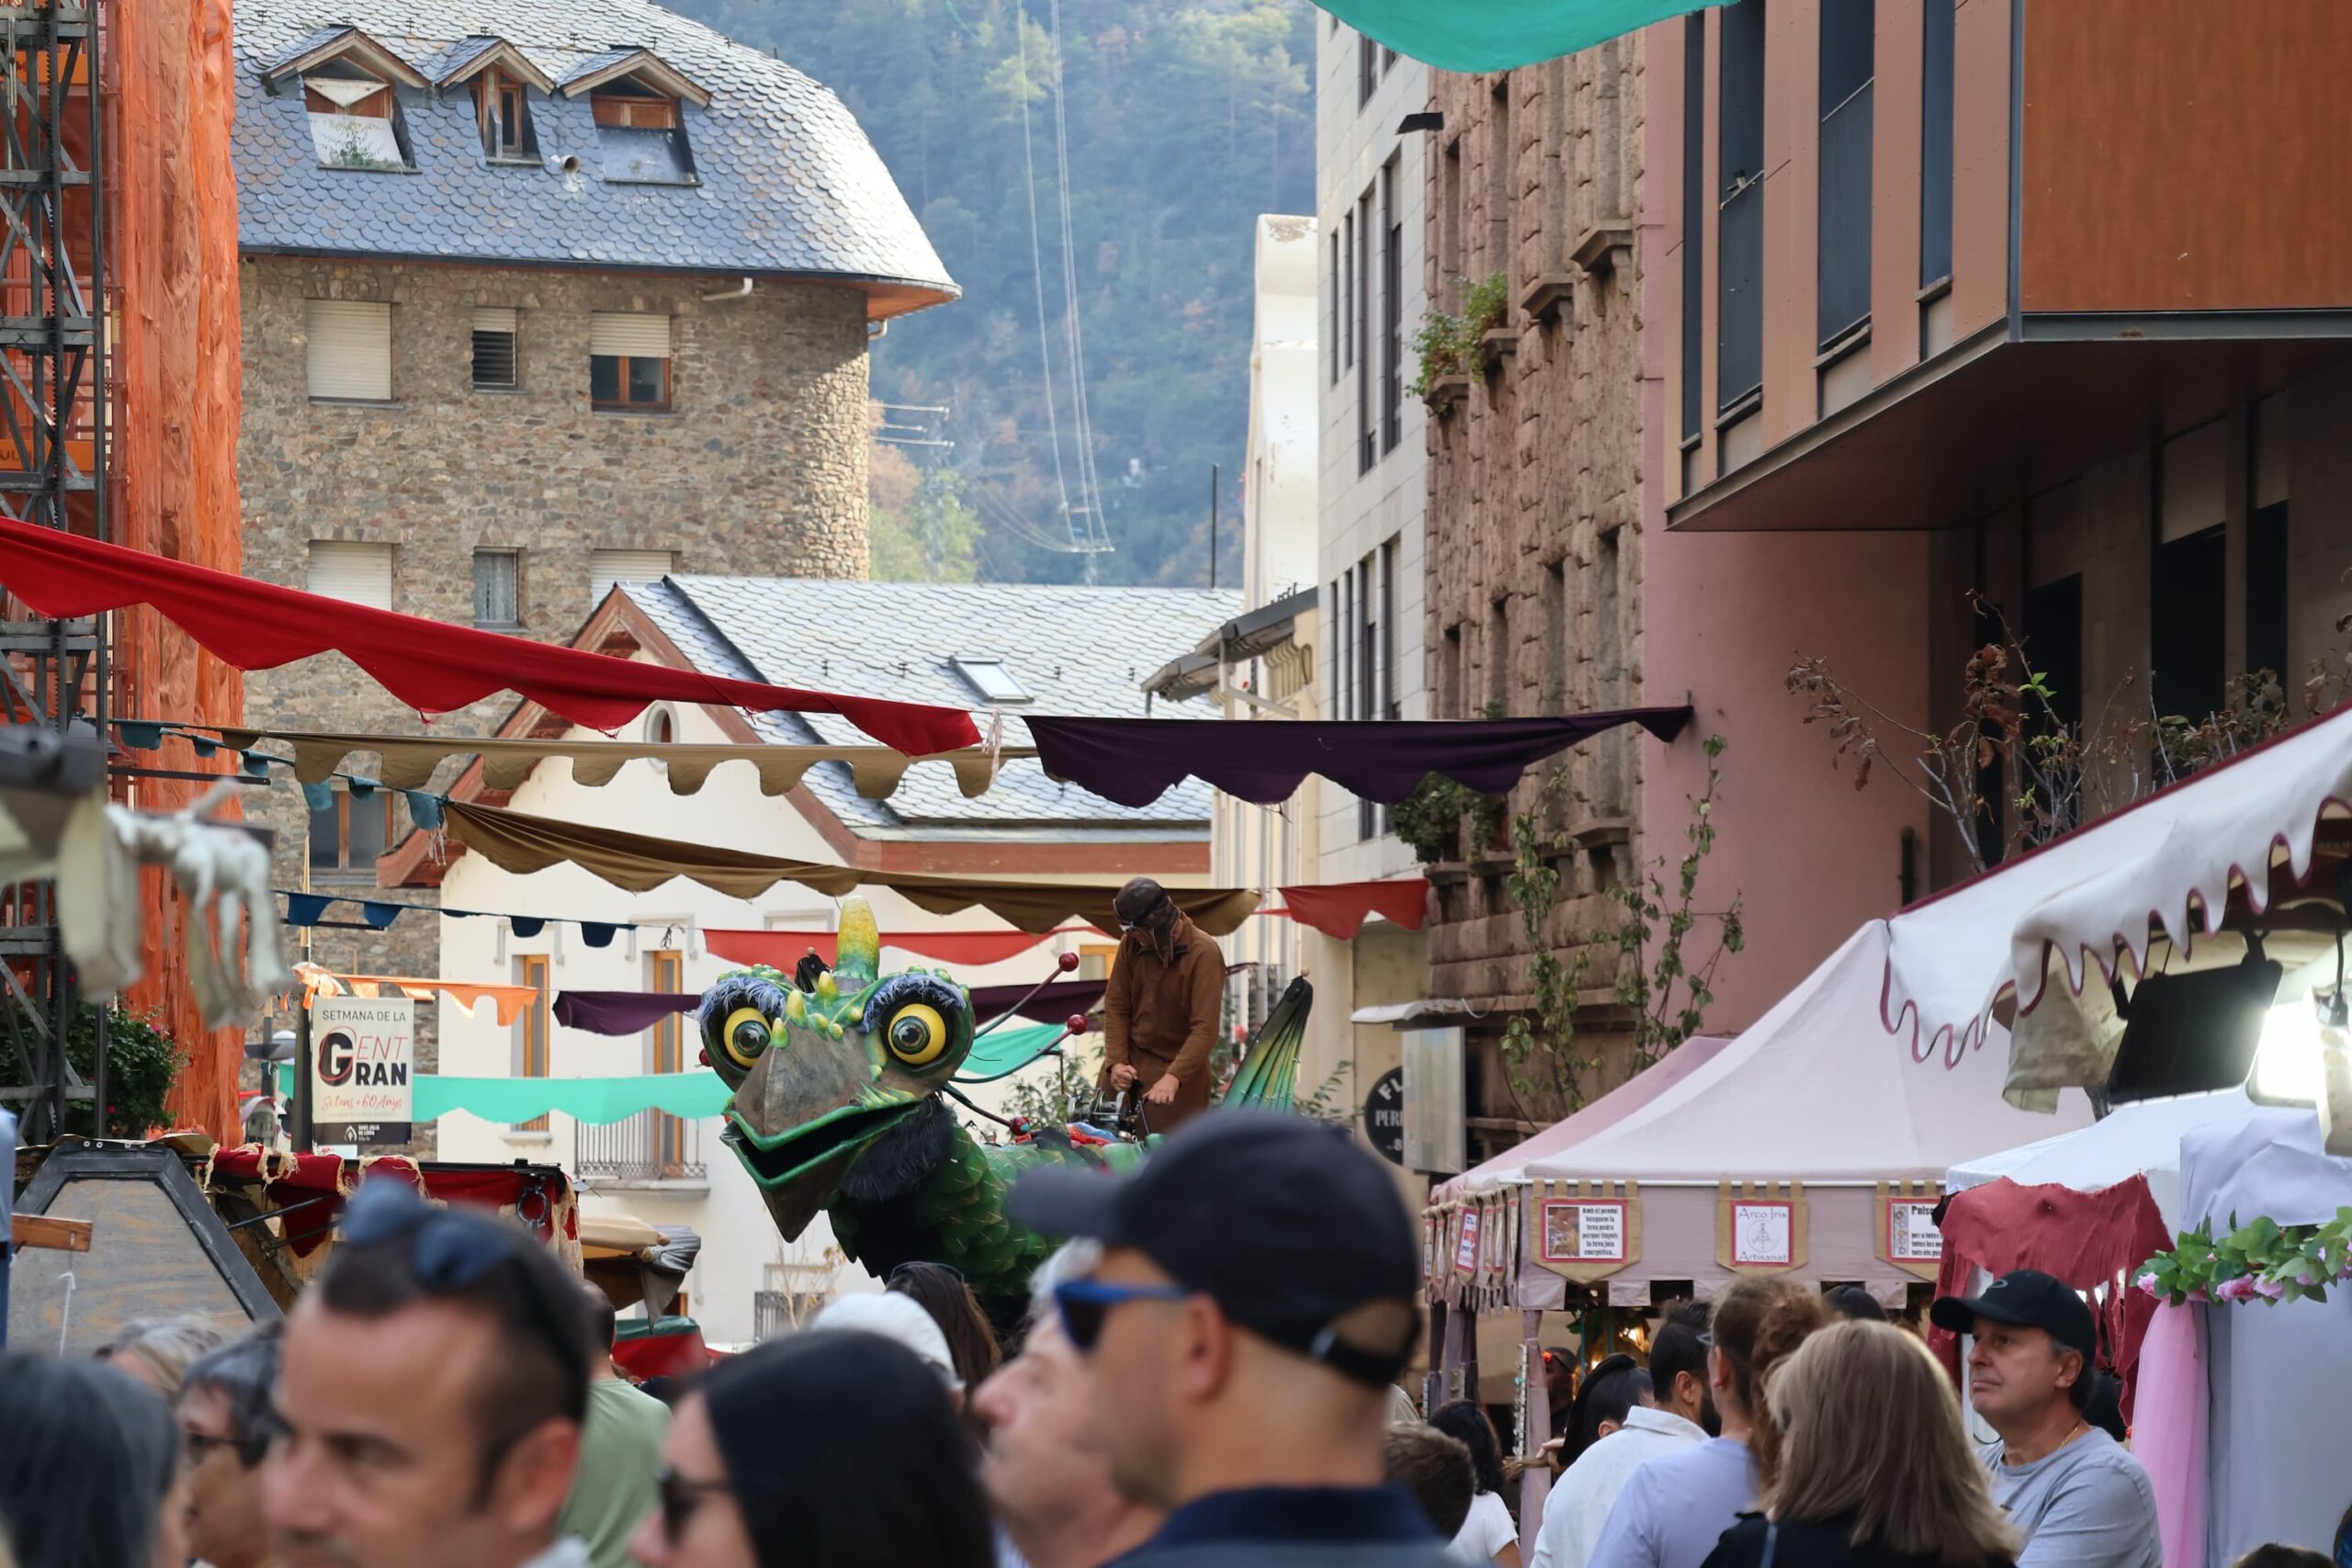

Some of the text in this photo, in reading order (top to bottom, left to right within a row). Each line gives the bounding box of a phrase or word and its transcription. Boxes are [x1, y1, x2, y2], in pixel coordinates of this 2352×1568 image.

[322, 1010, 406, 1021] SETMANA DE LA
[1738, 1207, 1786, 1220] Arco Iris
[1739, 1251, 1786, 1262] Artisanat
